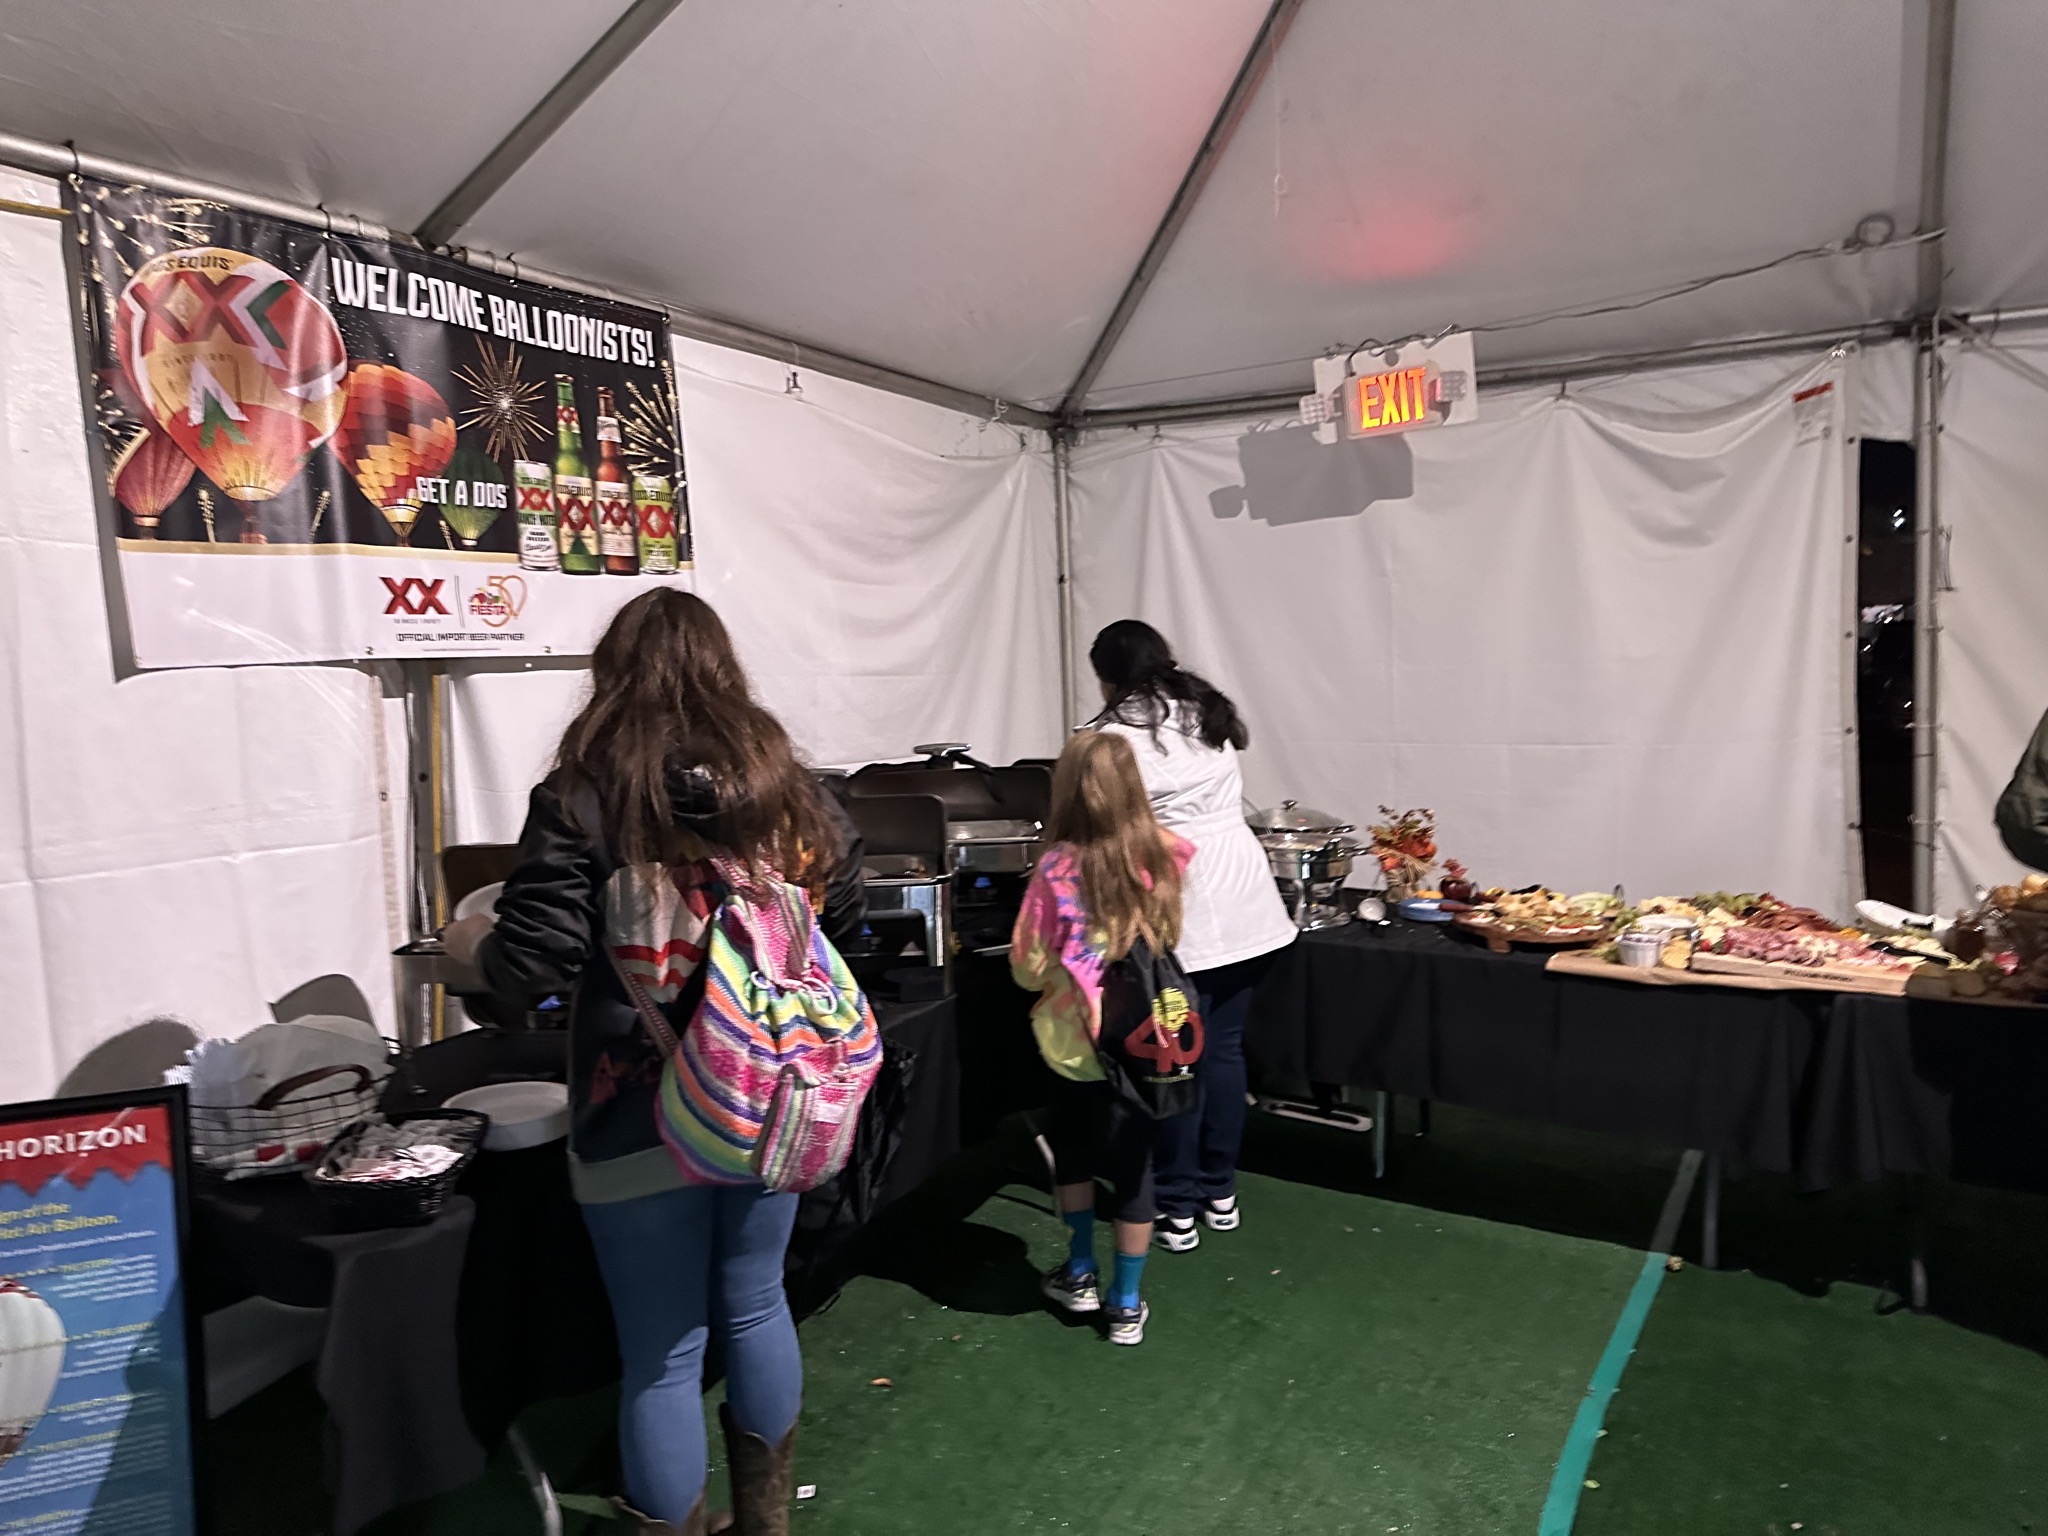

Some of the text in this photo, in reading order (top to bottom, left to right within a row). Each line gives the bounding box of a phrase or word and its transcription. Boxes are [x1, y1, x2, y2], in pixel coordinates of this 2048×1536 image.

[177, 255, 230, 270] EQUIS
[331, 257, 656, 368] WELCOME BALLOONISTS!
[1358, 366, 1426, 429] EXIT
[416, 476, 508, 509] GET A DOS
[378, 577, 453, 615] XX
[0, 1124, 147, 1161] HORIZON
